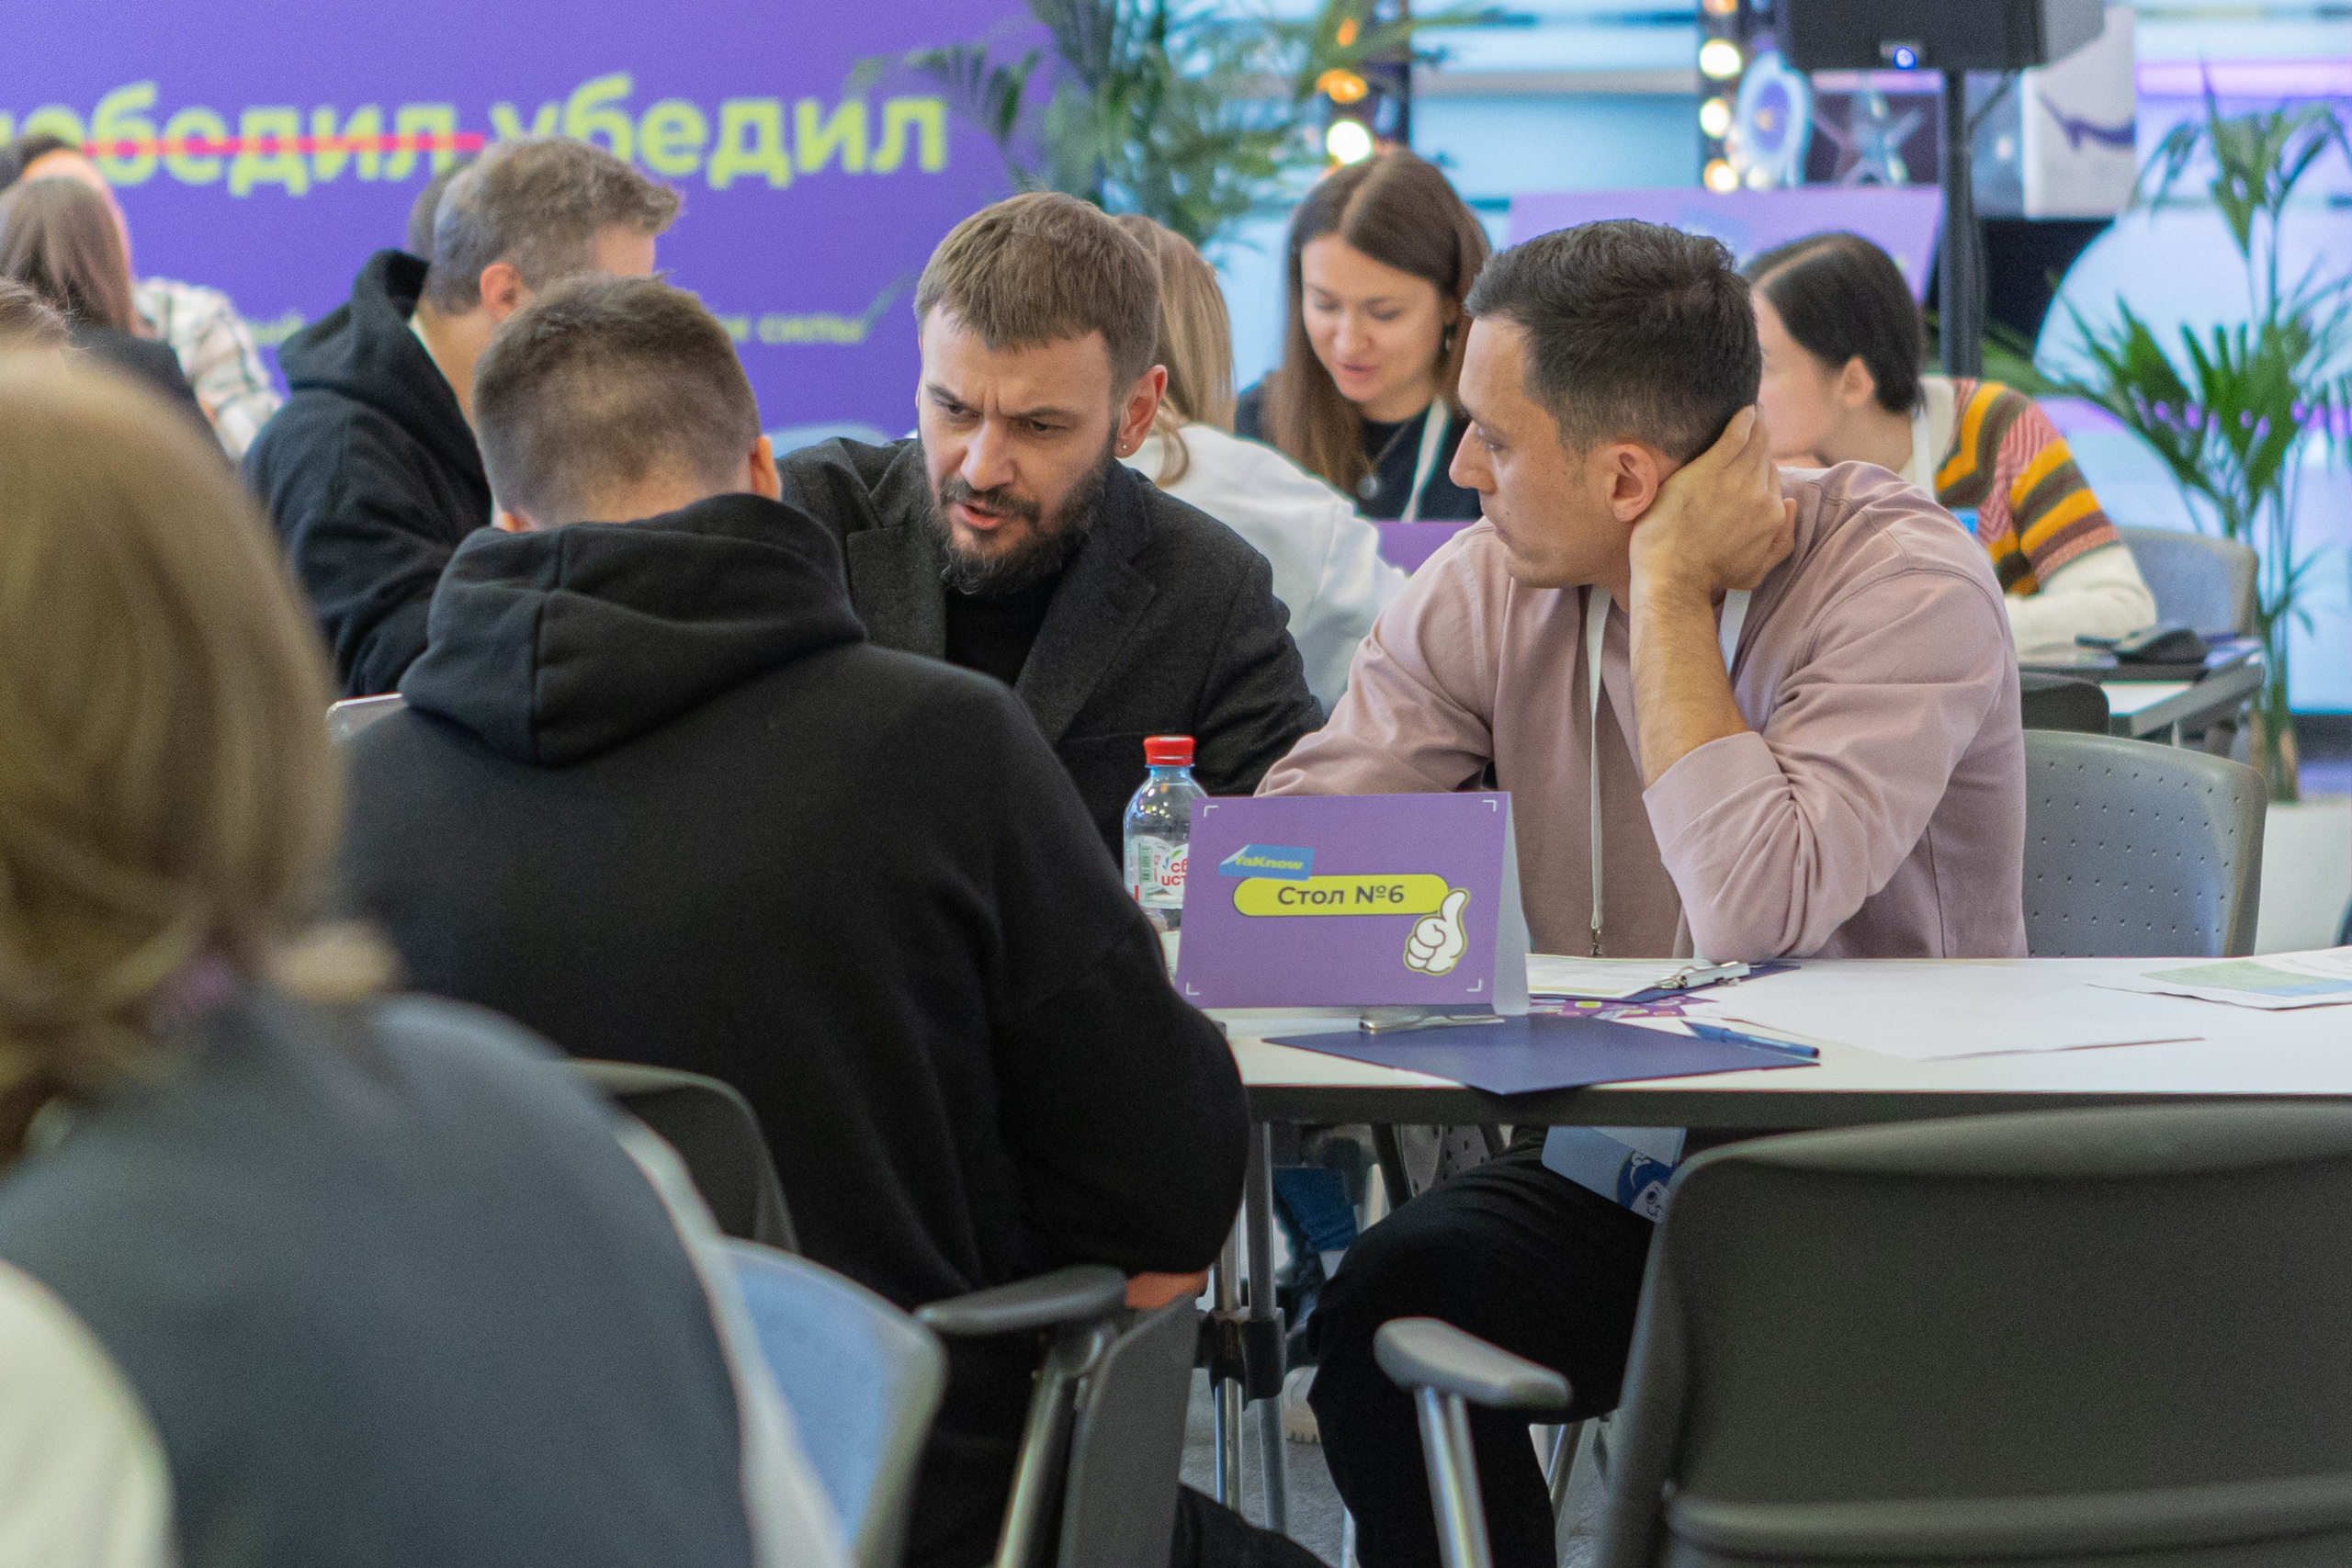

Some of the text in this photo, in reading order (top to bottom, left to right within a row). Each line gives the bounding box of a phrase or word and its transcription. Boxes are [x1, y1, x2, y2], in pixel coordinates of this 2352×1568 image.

[0, 81, 458, 197] бедил
[1277, 885, 1405, 906] Стол №6
